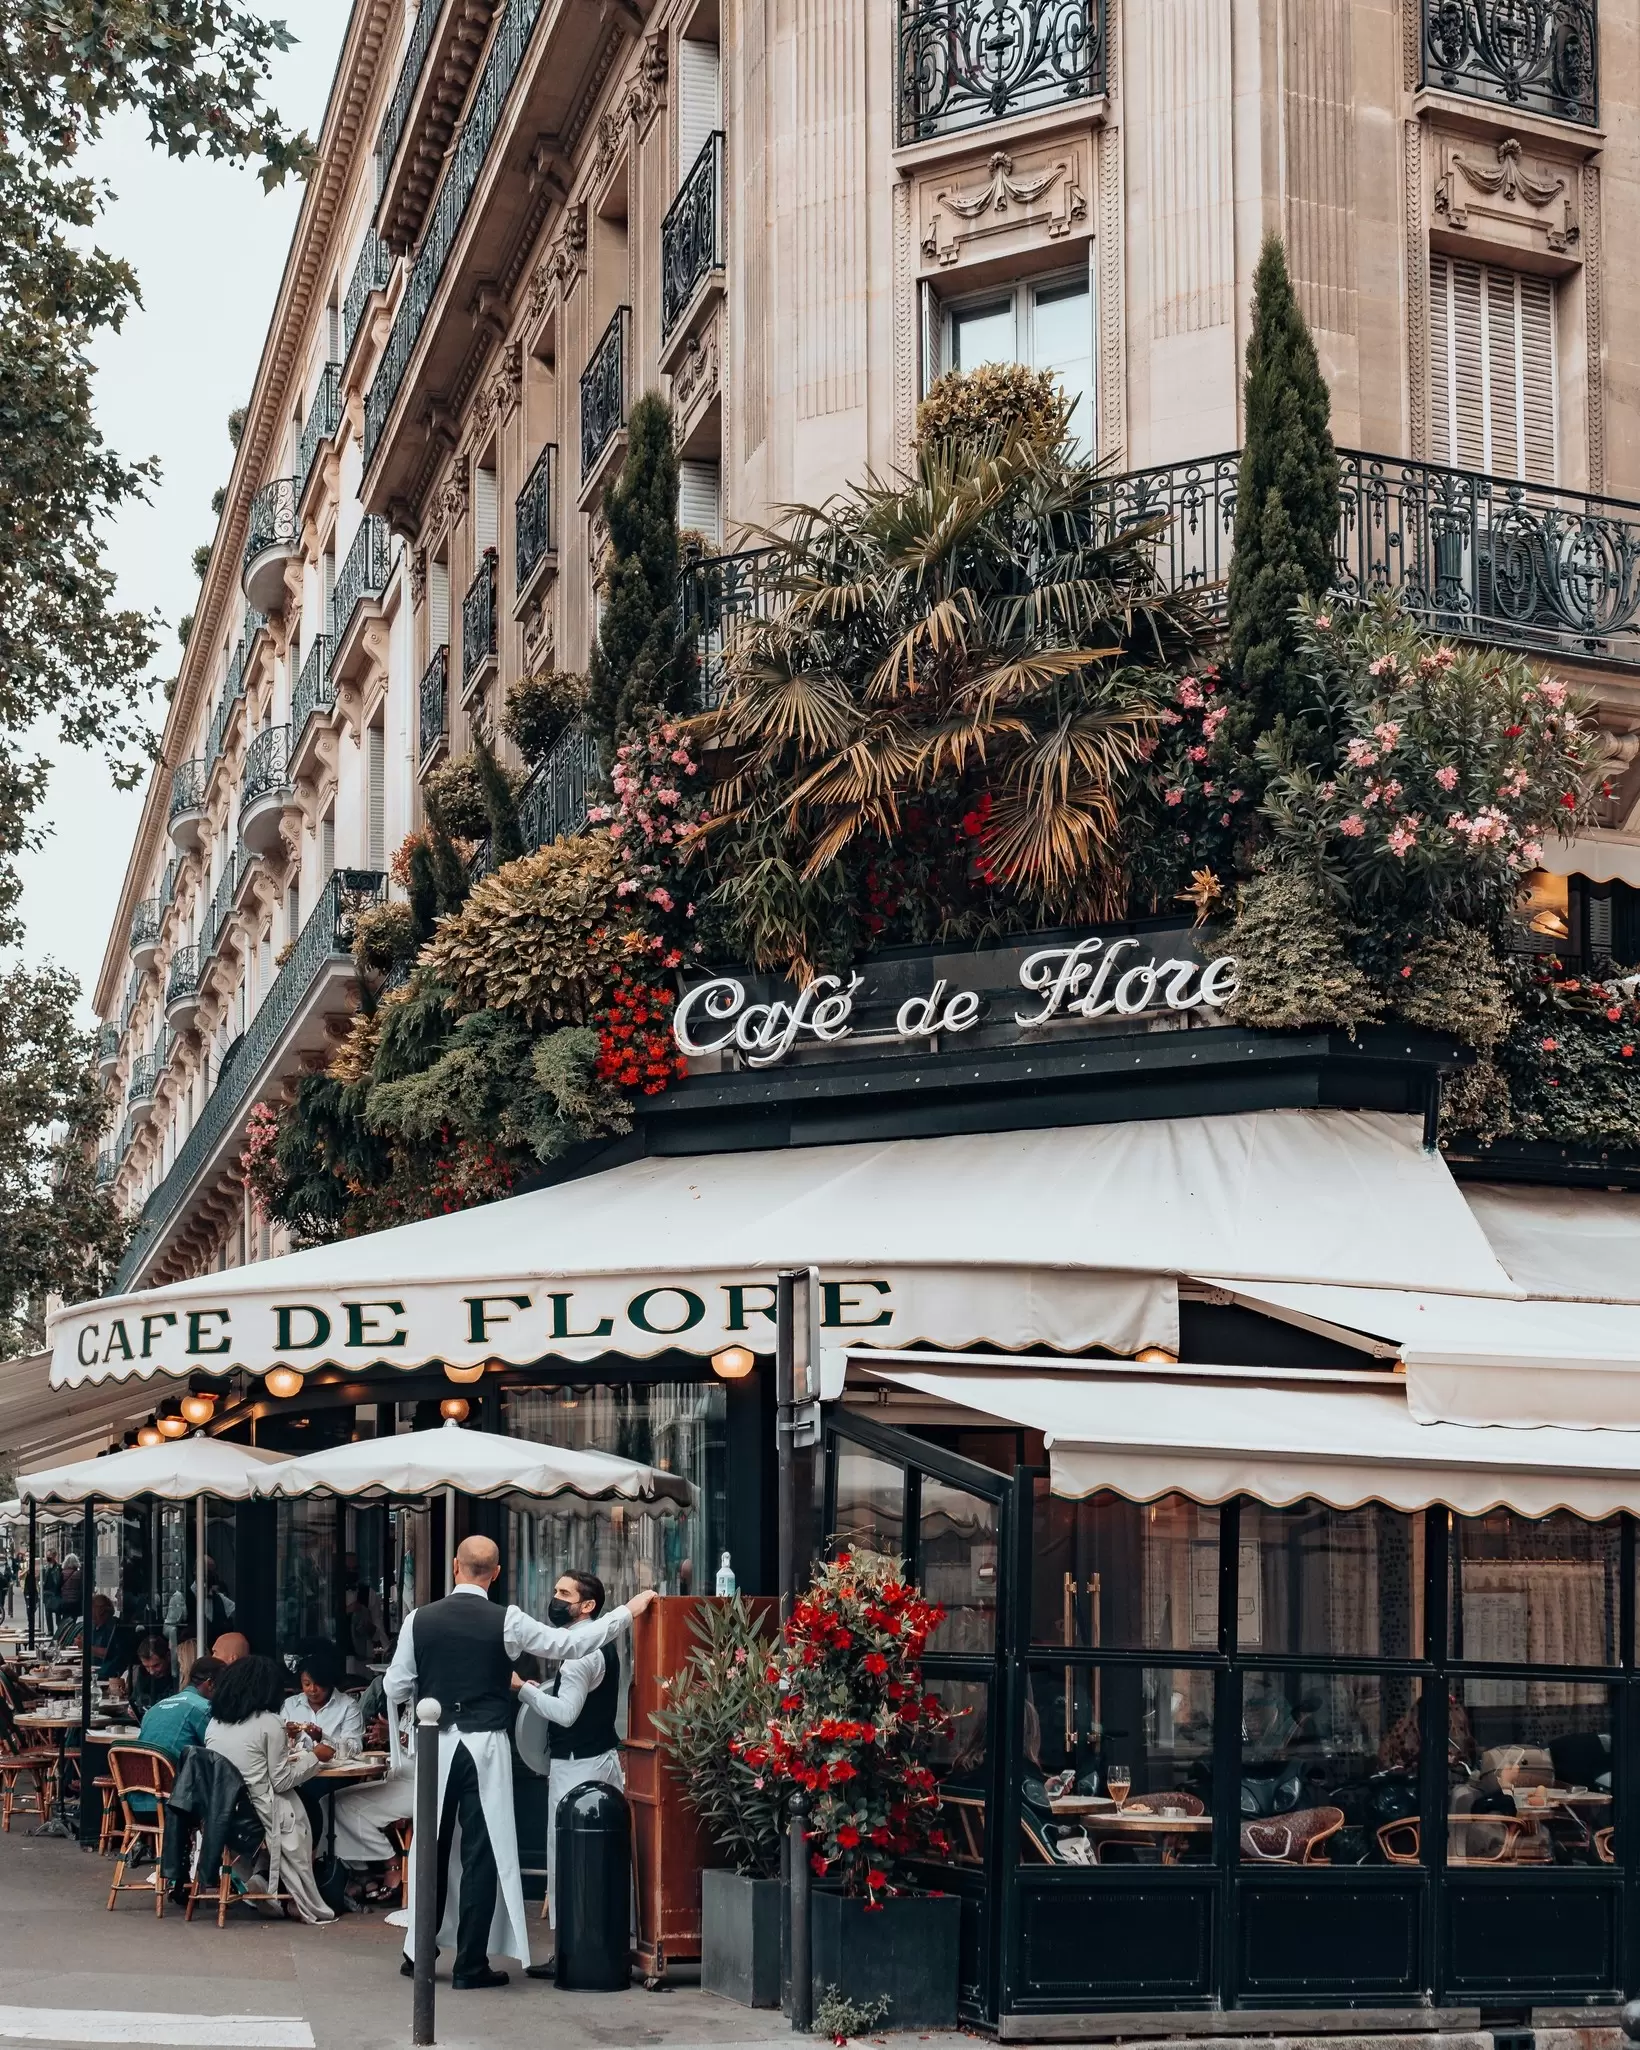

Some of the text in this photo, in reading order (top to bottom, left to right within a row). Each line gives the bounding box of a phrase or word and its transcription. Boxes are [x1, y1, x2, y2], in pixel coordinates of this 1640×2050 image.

[673, 936, 1241, 1067] Café de Flore
[77, 1279, 897, 1366] CAFE DE FLORE
